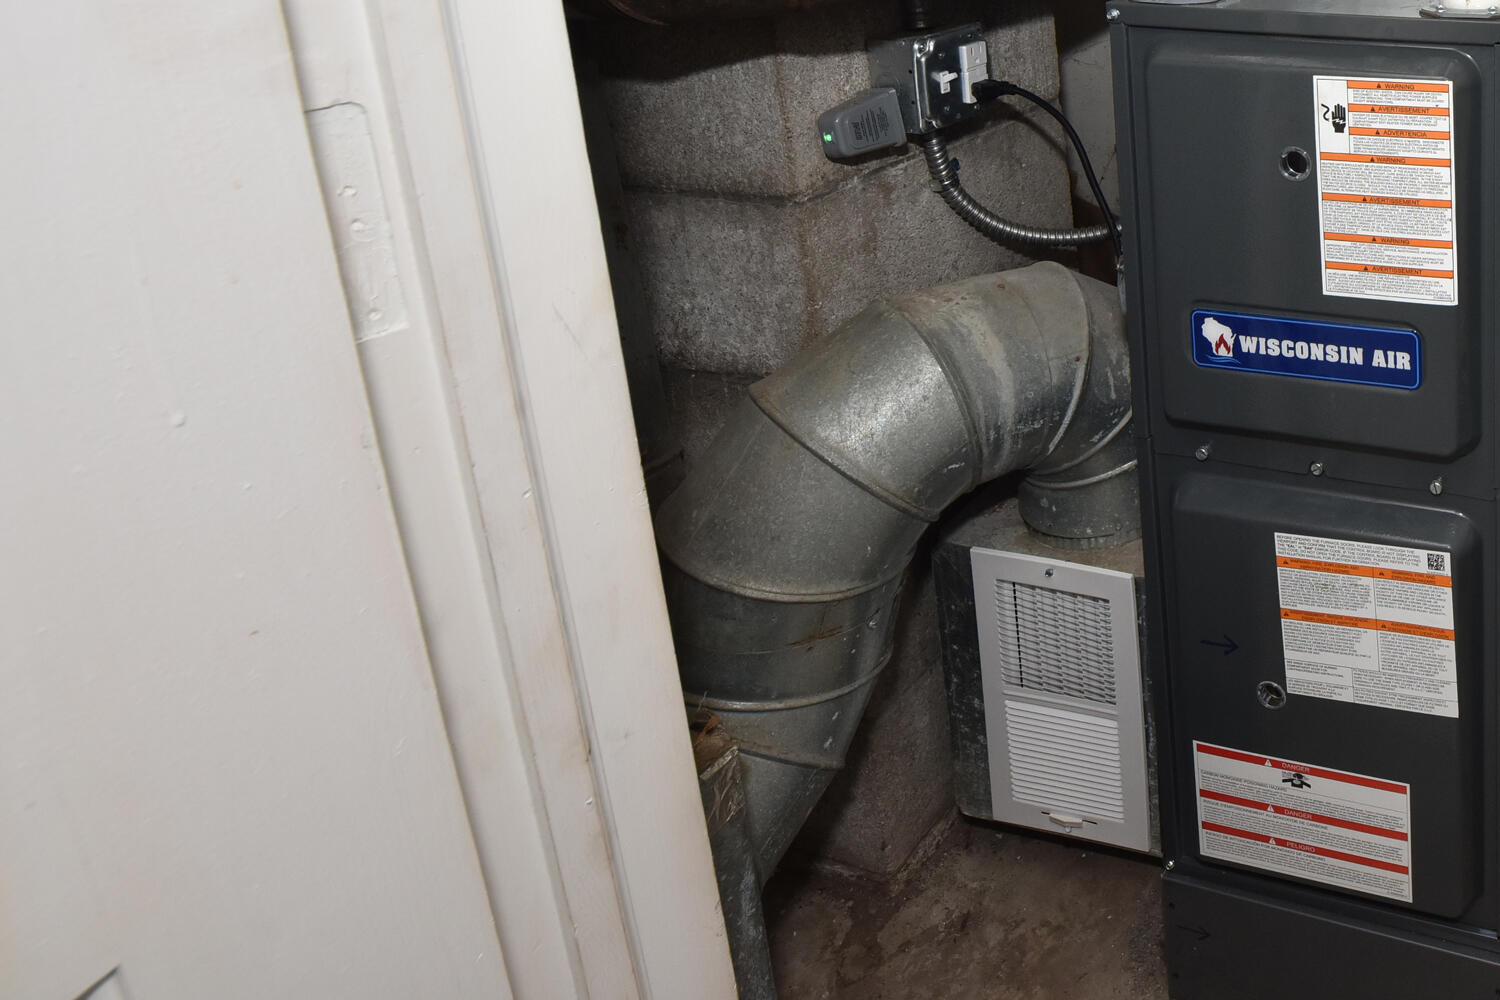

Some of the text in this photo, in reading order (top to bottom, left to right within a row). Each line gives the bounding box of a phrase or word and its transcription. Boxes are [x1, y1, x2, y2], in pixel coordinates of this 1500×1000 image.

[1239, 335, 1412, 370] WISCONSIN AIR
[1282, 762, 1310, 772] DANGER
[1284, 809, 1312, 819] DANGER
[1287, 842, 1316, 852] PELIGRO
